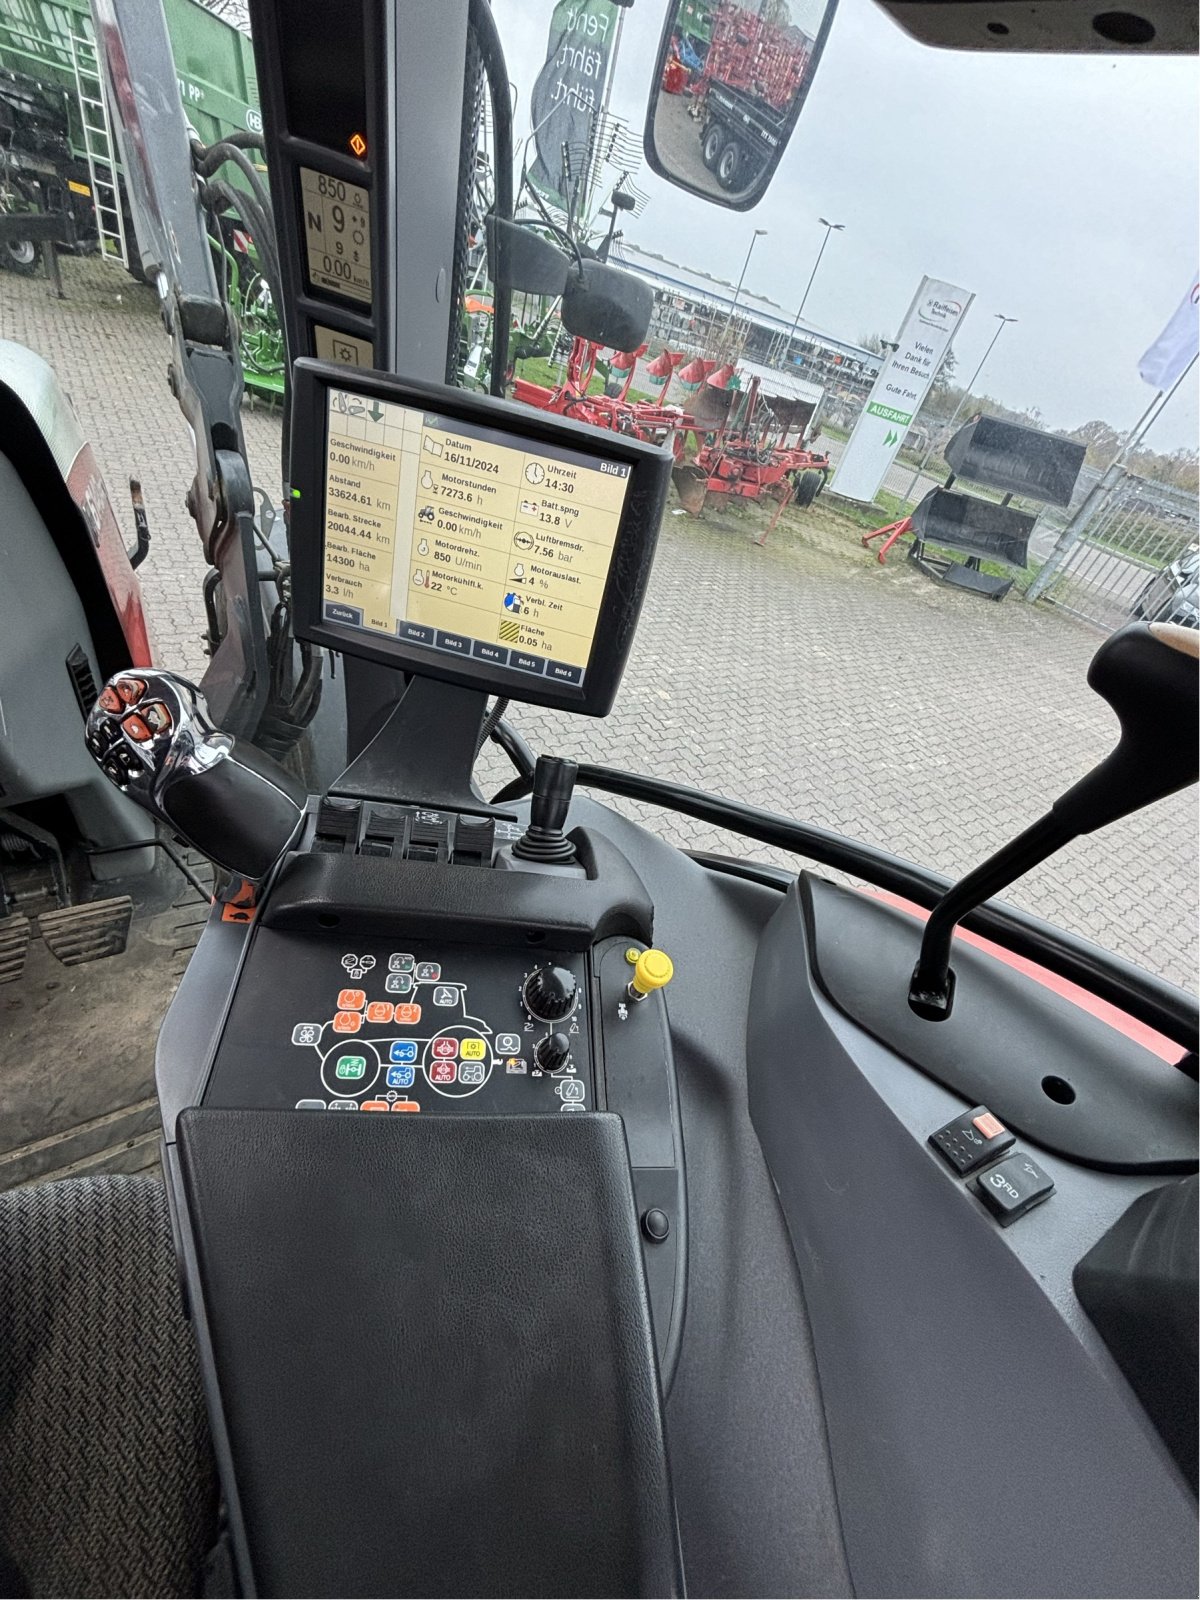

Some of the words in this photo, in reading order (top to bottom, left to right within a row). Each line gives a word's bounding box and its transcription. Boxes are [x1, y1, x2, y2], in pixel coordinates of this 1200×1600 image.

[318, 175, 346, 202] 850
[308, 212, 322, 233] N
[332, 205, 345, 233] 9
[336, 241, 343, 255] 9
[323, 256, 351, 280] 0.00
[915, 341, 933, 354] Vielen
[905, 352, 921, 364] Dank
[922, 357, 931, 367] für
[892, 360, 909, 373] Ihren
[910, 366, 930, 379] Besuch
[886, 384, 902, 394] Gute
[870, 405, 910, 424] AUSFAHRT
[330, 438, 396, 462] Geschwindigkeit
[445, 438, 472, 451] Datum
[330, 451, 350, 464] 0.00
[352, 456, 375, 471] km/h
[444, 452, 499, 474] 16/11/2024
[547, 464, 577, 480] Uhrzeit
[600, 462, 619, 475] Bild
[621, 468, 626, 477] 1
[329, 474, 361, 488] Abstand
[442, 473, 496, 494] Motorstunden
[544, 478, 574, 494] 14:30
[328, 487, 372, 506] 33624.61
[377, 498, 391, 511] km
[440, 486, 472, 502] 7273.6
[477, 495, 482, 505] h
[541, 499, 580, 517] Batt.spng
[328, 508, 351, 520] Bearb.
[352, 515, 382, 528] Strecke
[438, 507, 503, 530] Geschwindigkeit
[539, 512, 560, 526] 13.8
[564, 518, 572, 528] V
[327, 521, 372, 540] 20044.44
[376, 532, 390, 544] km
[437, 520, 457, 532] 0.00
[459, 525, 482, 539] km/h
[326, 542, 349, 553] Bearb.
[435, 540, 480, 557] Motordrehz.
[536, 532, 584, 552] Luftbremsdr.
[434, 551, 451, 563] 850
[455, 556, 482, 572] U/min
[534, 545, 554, 558] 7.56
[558, 551, 573, 563] bar
[327, 554, 355, 568] 14300
[359, 561, 370, 572] ha
[326, 573, 362, 588] Verbrauch
[530, 565, 581, 584] Motorauslast.
[326, 584, 339, 595] 3.3
[343, 587, 354, 598] l/h
[431, 582, 442, 592] 22
[446, 586, 458, 596] °C
[529, 577, 535, 585] 4
[540, 580, 548, 589] %
[526, 596, 546, 607] Verbl.
[548, 602, 563, 611] Zeit
[533, 608, 539, 617] h
[371, 619, 383, 627] Bild
[408, 628, 420, 637] Bild
[444, 638, 457, 647] Bild
[519, 636, 538, 647] 0.05
[541, 641, 552, 651] ha
[482, 648, 493, 657] Bild
[518, 658, 531, 666] Bild
[555, 668, 567, 676] Bild
[990, 1173, 1019, 1199] 3RD
